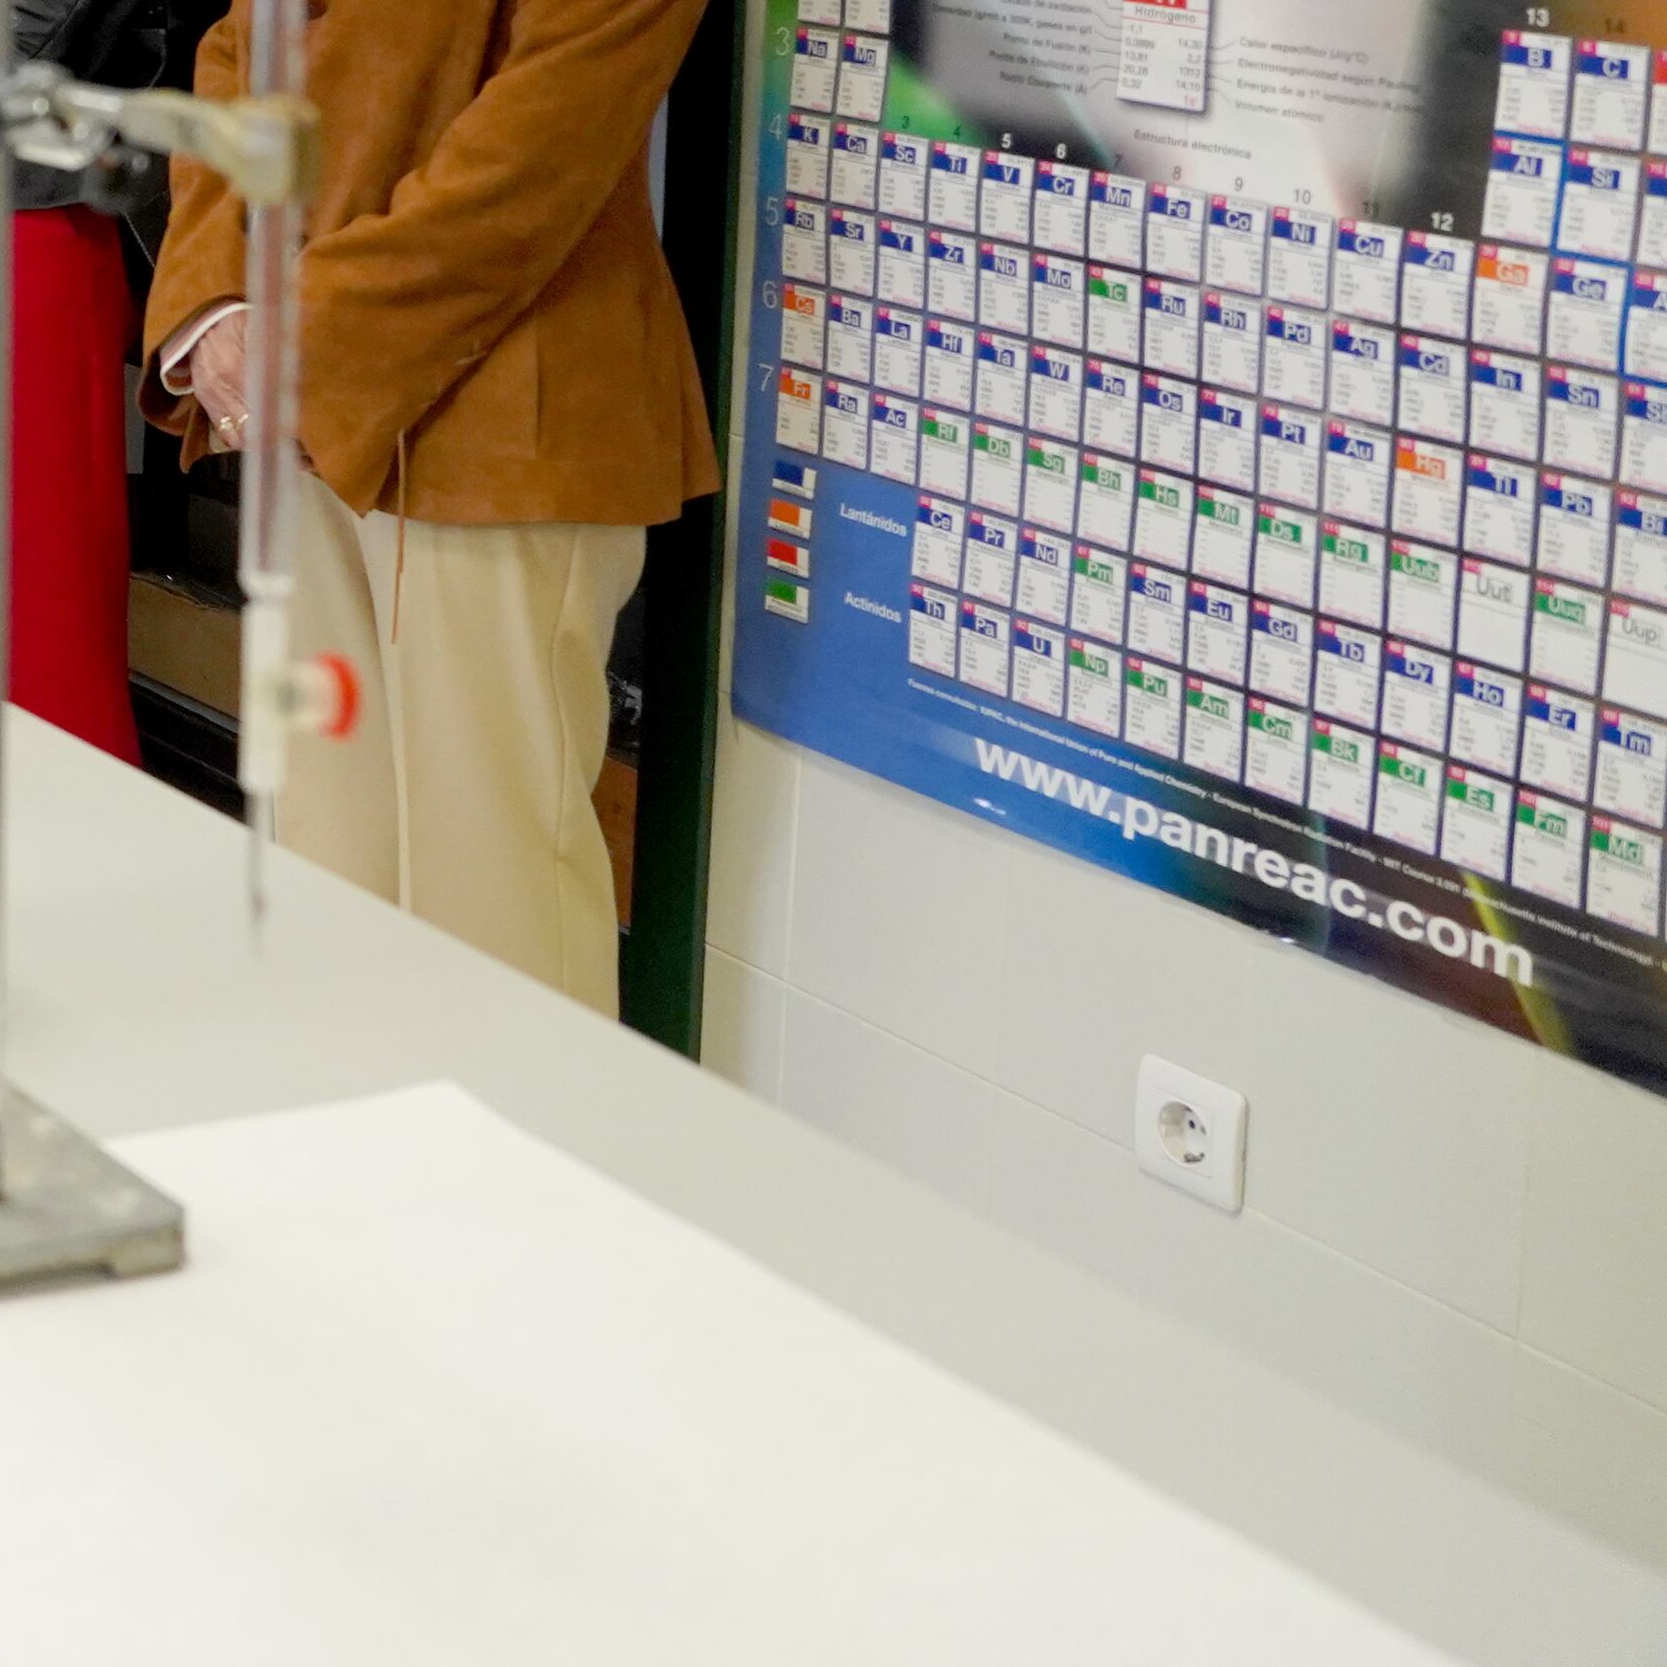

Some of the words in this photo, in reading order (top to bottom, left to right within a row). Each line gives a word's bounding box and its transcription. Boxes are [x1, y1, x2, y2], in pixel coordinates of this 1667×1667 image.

[846, 133, 866, 153] Ca
[1002, 166, 1015, 183] V
[1173, 166, 1181, 180] 8
[1513, 155, 1536, 175] Al
[1052, 175, 1072, 194] Cr
[1105, 186, 1131, 207] Mn
[1293, 189, 1311, 205] 10
[1167, 200, 1187, 218] Fe
[1225, 212, 1251, 230] Co
[1430, 212, 1453, 232] 12
[1290, 222, 1311, 242] Ni
[1354, 233, 1383, 255] Cu
[993, 256, 1016, 276] Nb
[1426, 251, 1453, 270] Zn
[1046, 268, 1072, 288] Mo
[1144, 582, 1171, 600] Sm
[1268, 619, 1297, 641] Gd
[1474, 681, 1502, 704] Ho
[974, 737, 1534, 987] www.panreac.com
